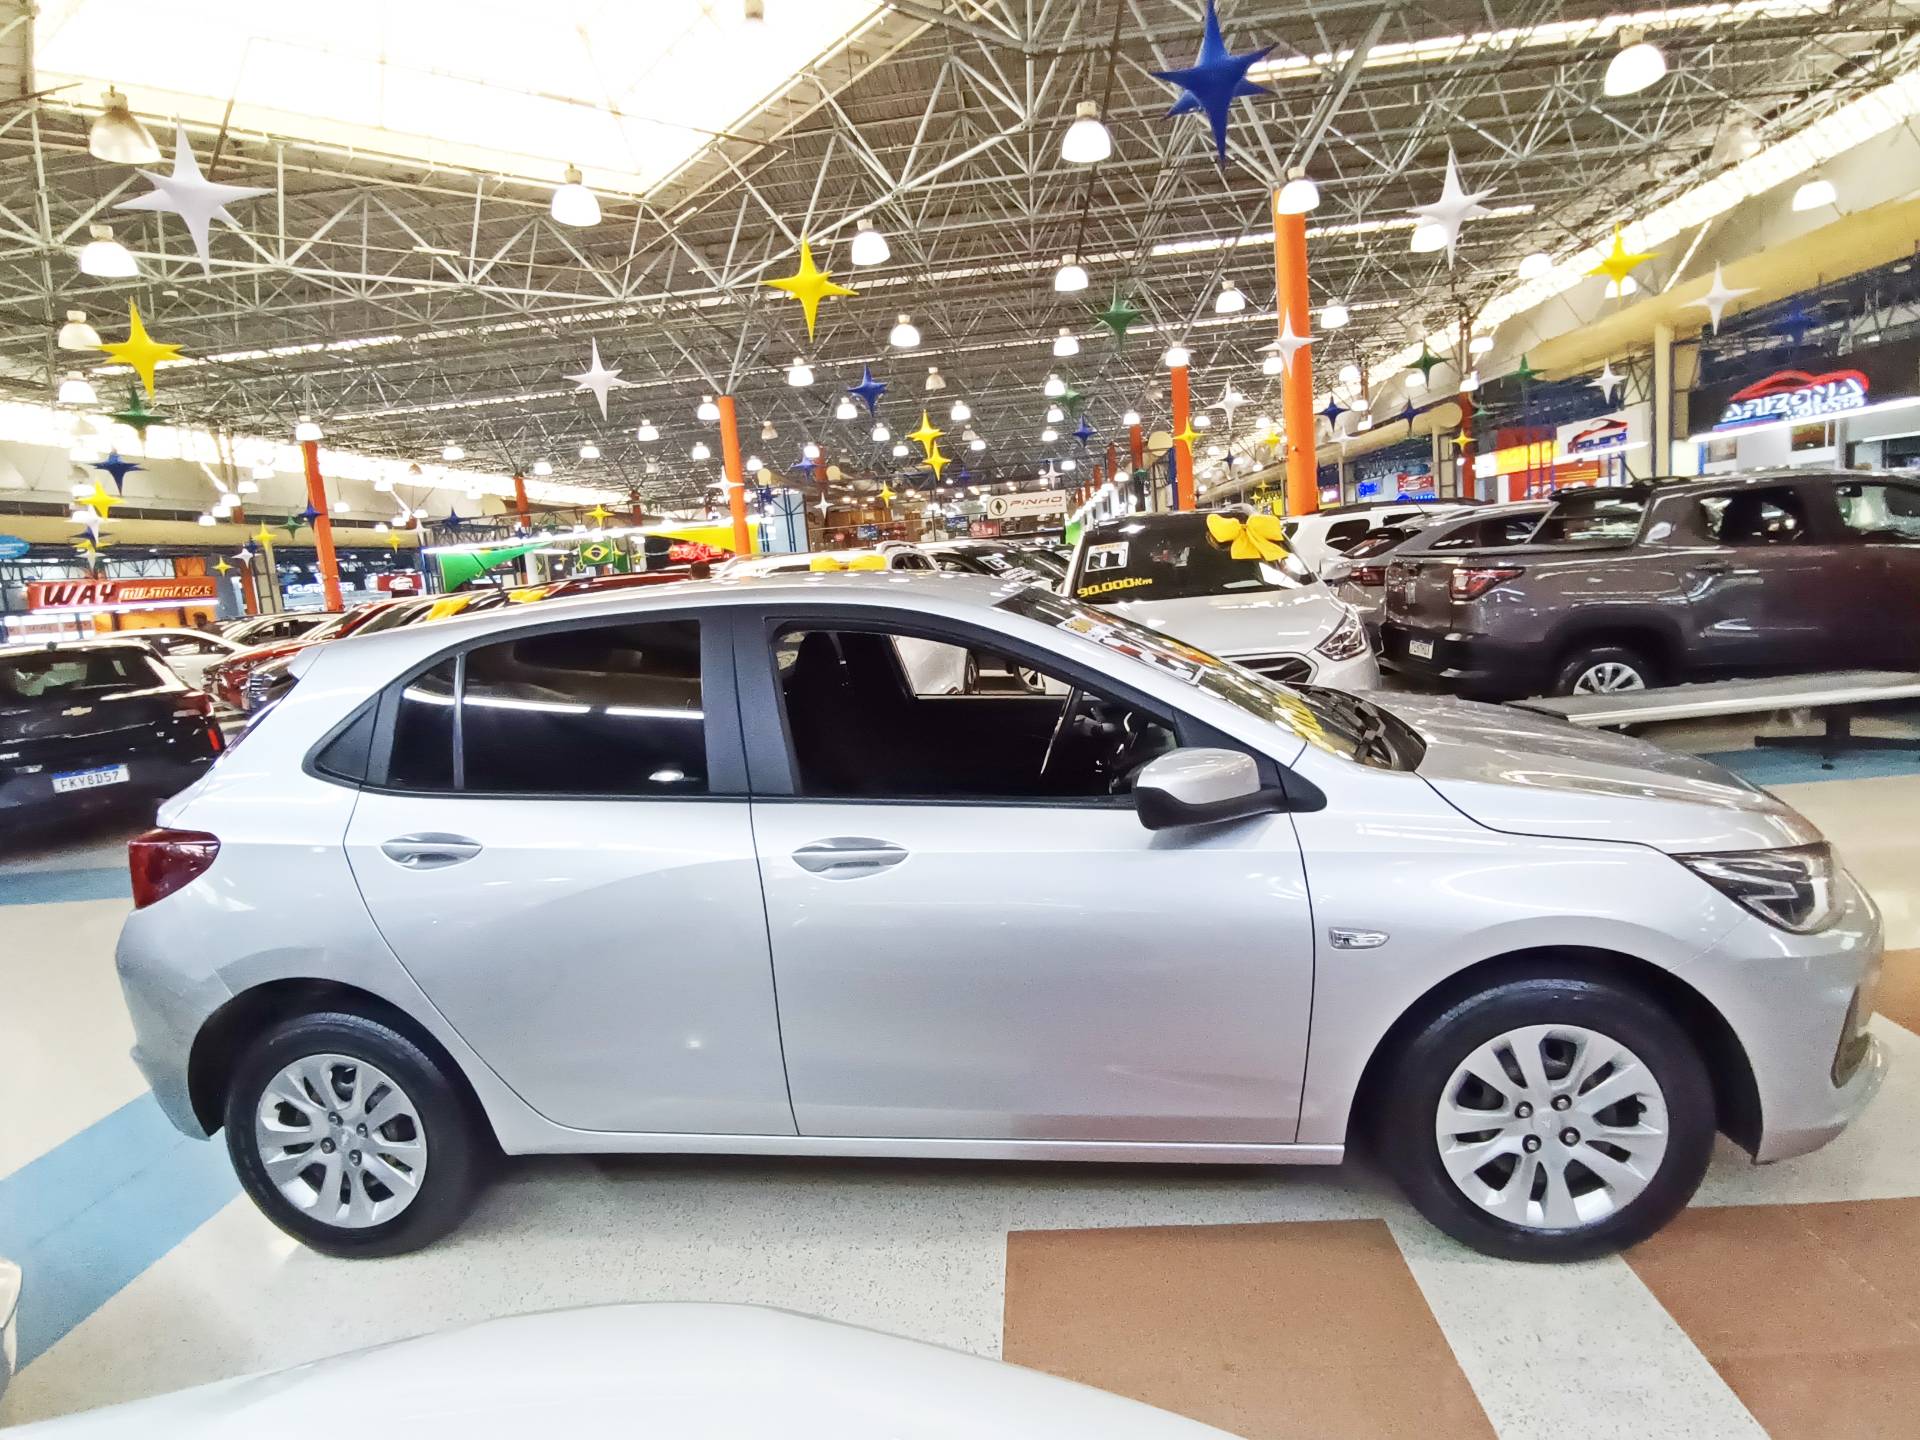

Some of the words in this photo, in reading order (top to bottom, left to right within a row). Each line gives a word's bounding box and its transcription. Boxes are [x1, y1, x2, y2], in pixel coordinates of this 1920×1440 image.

[1721, 377, 1864, 423] ARIZONA
[43, 583, 116, 606] WAY
[60, 770, 120, 790] FKY8D57
